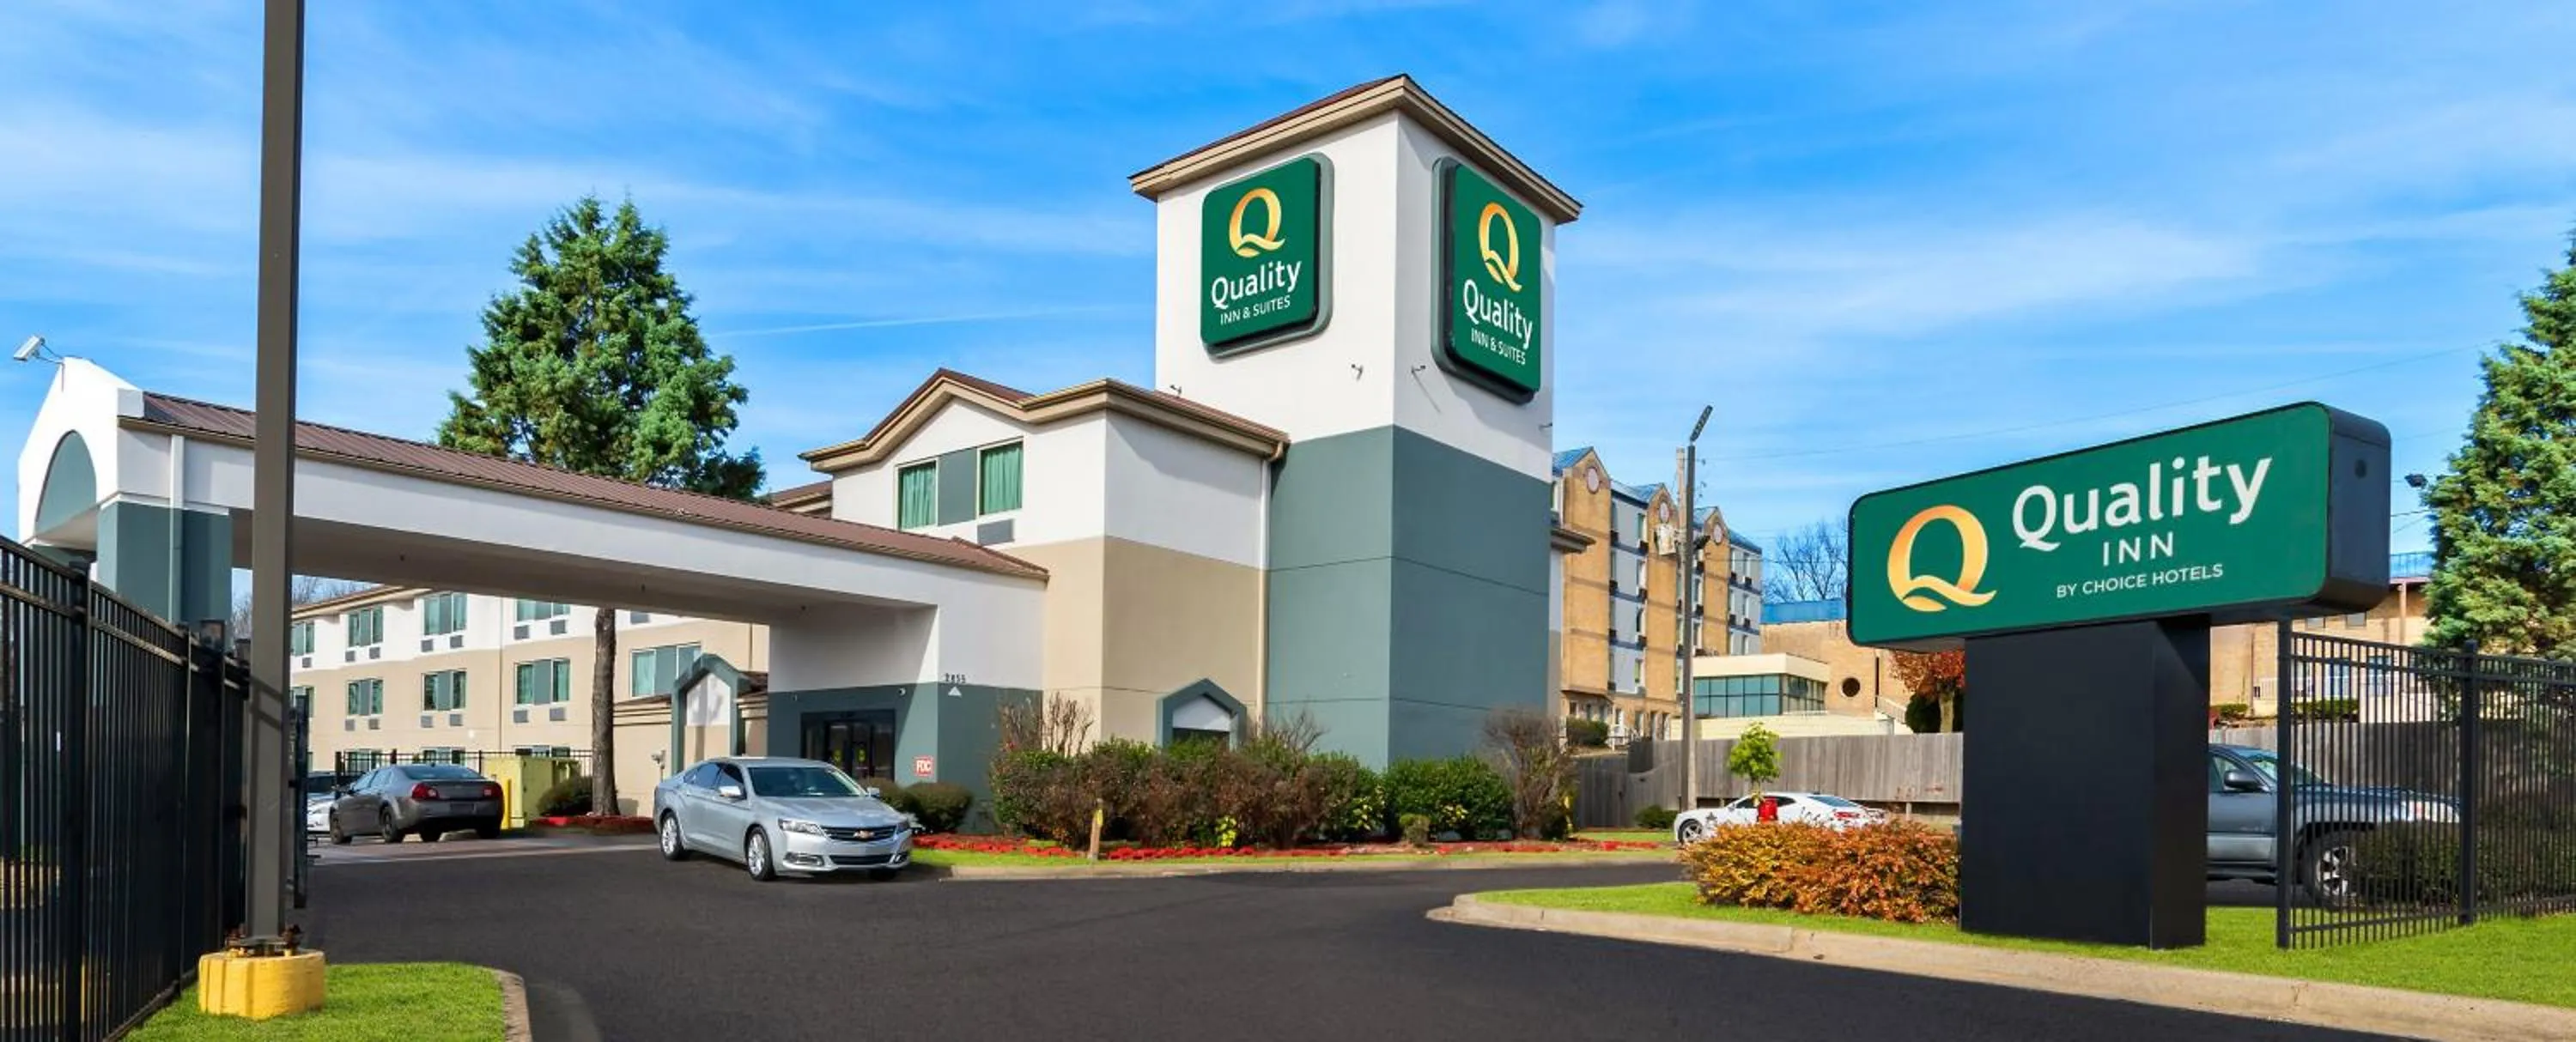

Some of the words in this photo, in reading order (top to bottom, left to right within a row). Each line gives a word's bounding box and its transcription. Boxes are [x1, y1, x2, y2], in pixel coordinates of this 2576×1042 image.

[1229, 188, 1285, 257] Q
[1478, 203, 1522, 292] Q
[1212, 260, 1302, 310] Quality
[1220, 309, 1242, 325] INN
[1242, 306, 1251, 319] &
[1253, 294, 1291, 317] SUITES
[1463, 279, 1533, 349] Quality
[1471, 327, 1489, 348] INN
[1490, 336, 1497, 352] &
[1498, 341, 1526, 366] SUITES
[2012, 455, 2273, 552] Quality
[1886, 504, 1997, 612] Q
[2103, 531, 2174, 566] INN
[2056, 583, 2077, 598] BY
[2082, 573, 2148, 594] CHOICE
[2152, 563, 2224, 585] HOTELS
